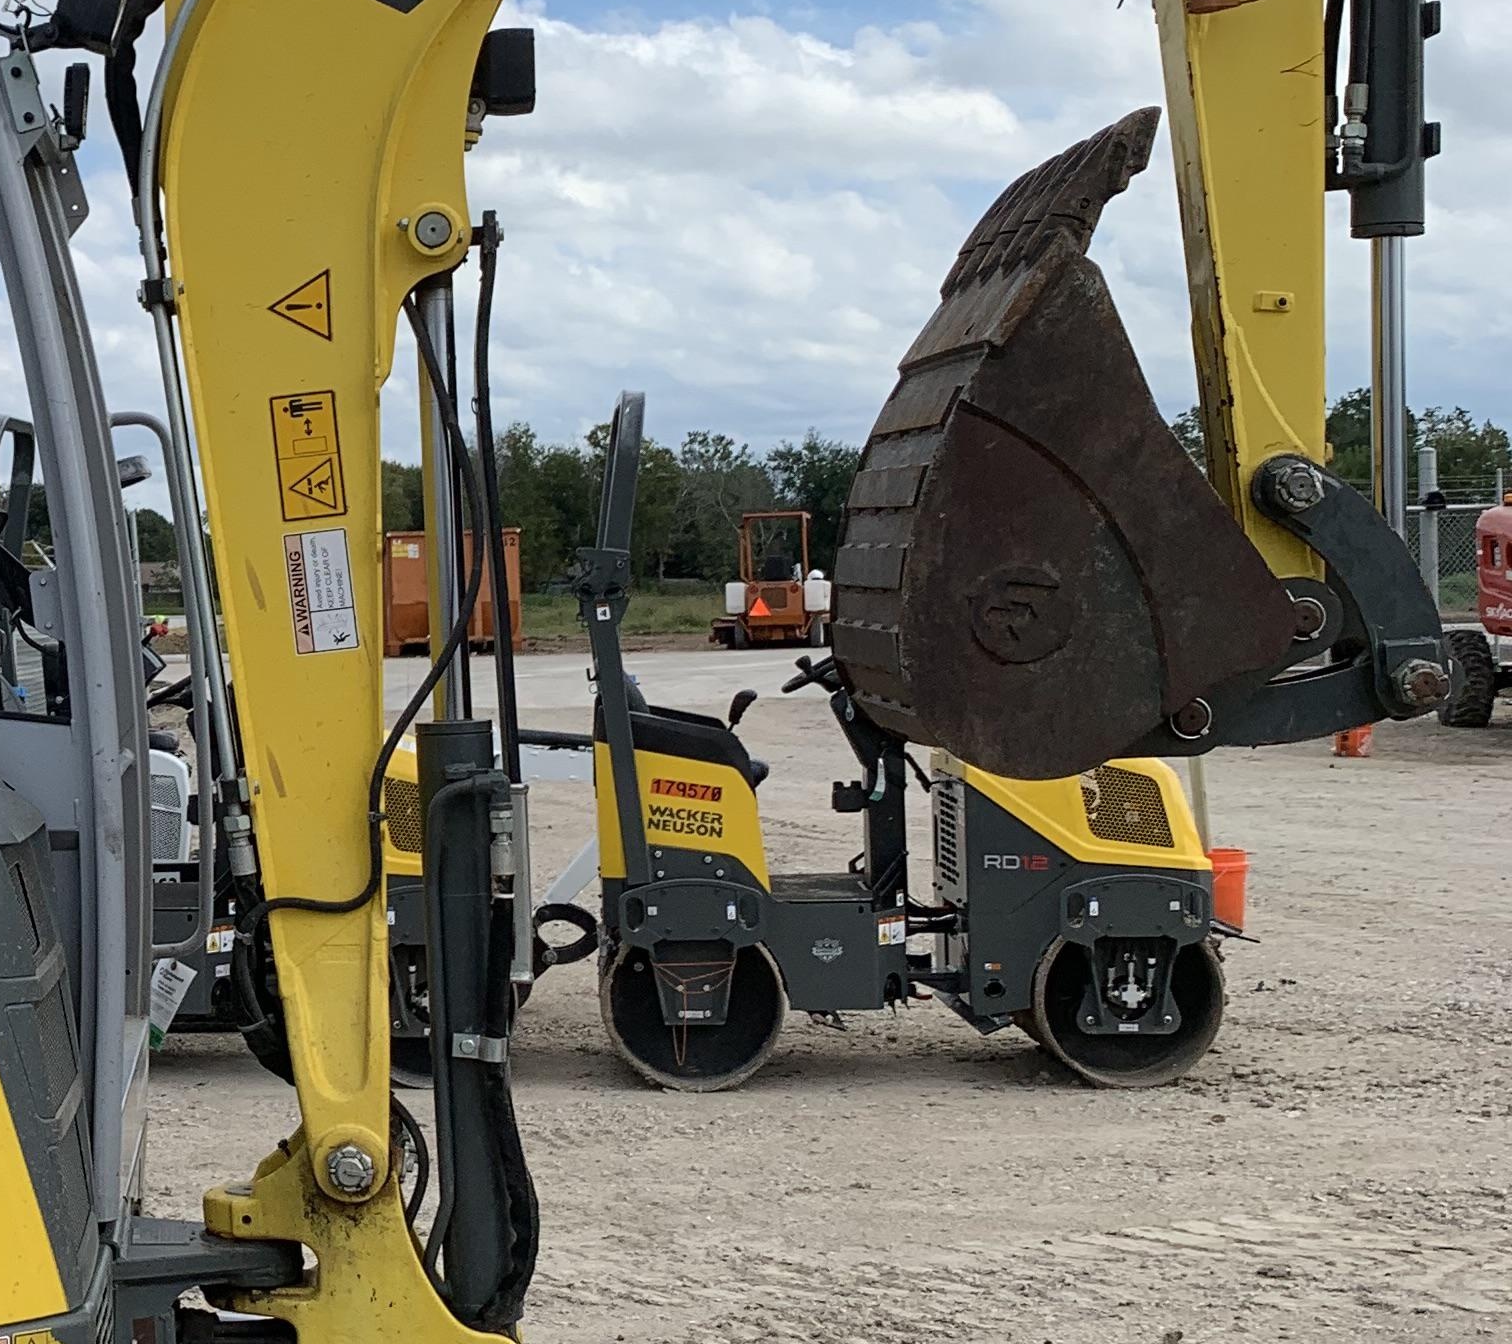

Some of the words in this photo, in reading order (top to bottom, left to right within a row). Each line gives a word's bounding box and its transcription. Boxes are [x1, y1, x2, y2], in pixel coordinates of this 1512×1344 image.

[321, 546, 329, 558] OF
[322, 559, 332, 587] CLEAR
[289, 550, 308, 623] WARNING
[324, 588, 335, 608] KEEP
[651, 778, 723, 802] 179570
[648, 804, 723, 826] WACKER
[647, 817, 723, 839] NEUSON
